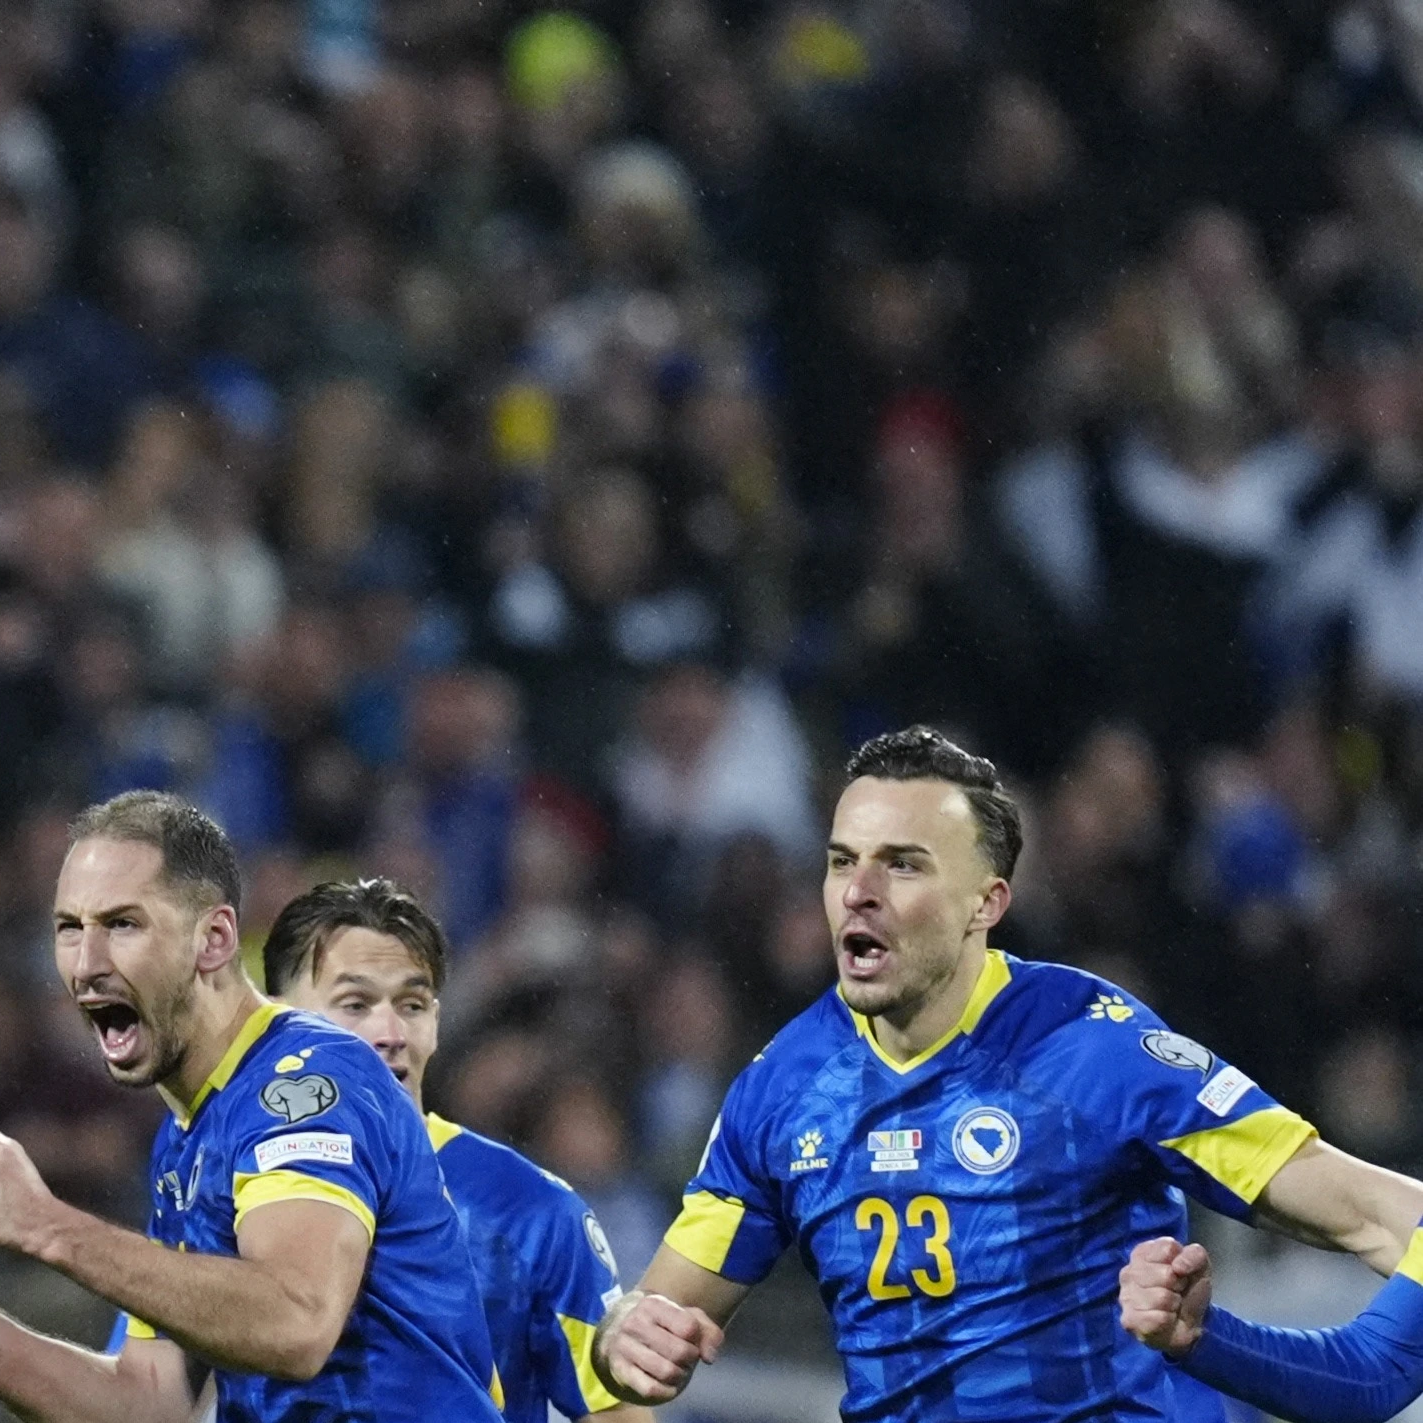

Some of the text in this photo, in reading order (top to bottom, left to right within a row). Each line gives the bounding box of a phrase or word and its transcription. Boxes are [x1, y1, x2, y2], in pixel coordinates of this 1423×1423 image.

[258, 1141, 350, 1161] FOUNDATION
[789, 1158, 829, 1173] KELME
[855, 1194, 956, 1301] 23
